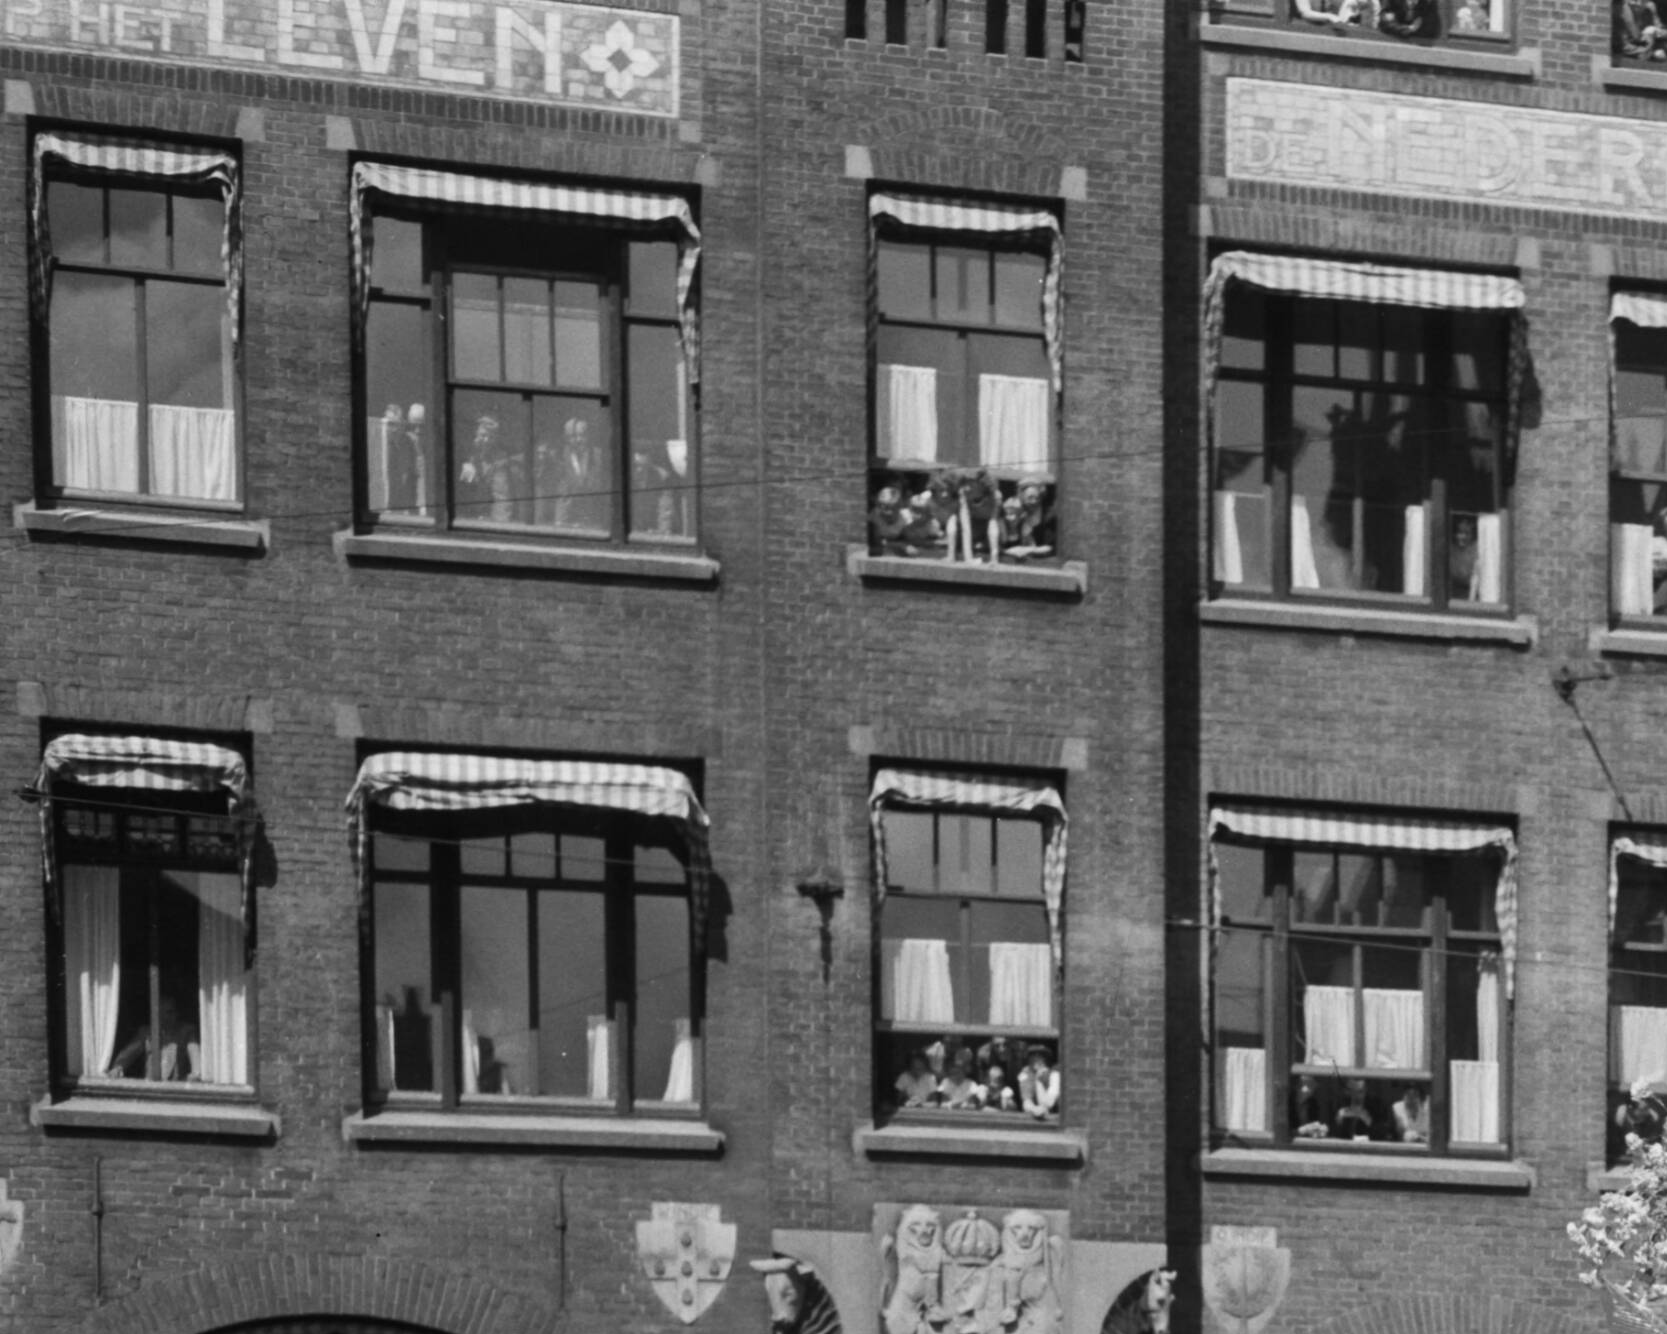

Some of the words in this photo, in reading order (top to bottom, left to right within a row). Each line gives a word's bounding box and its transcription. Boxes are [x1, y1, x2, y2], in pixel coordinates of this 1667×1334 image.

[70, 0, 183, 51] HET
[206, 0, 564, 94] LEVEN
[1240, 131, 1315, 173] DE
